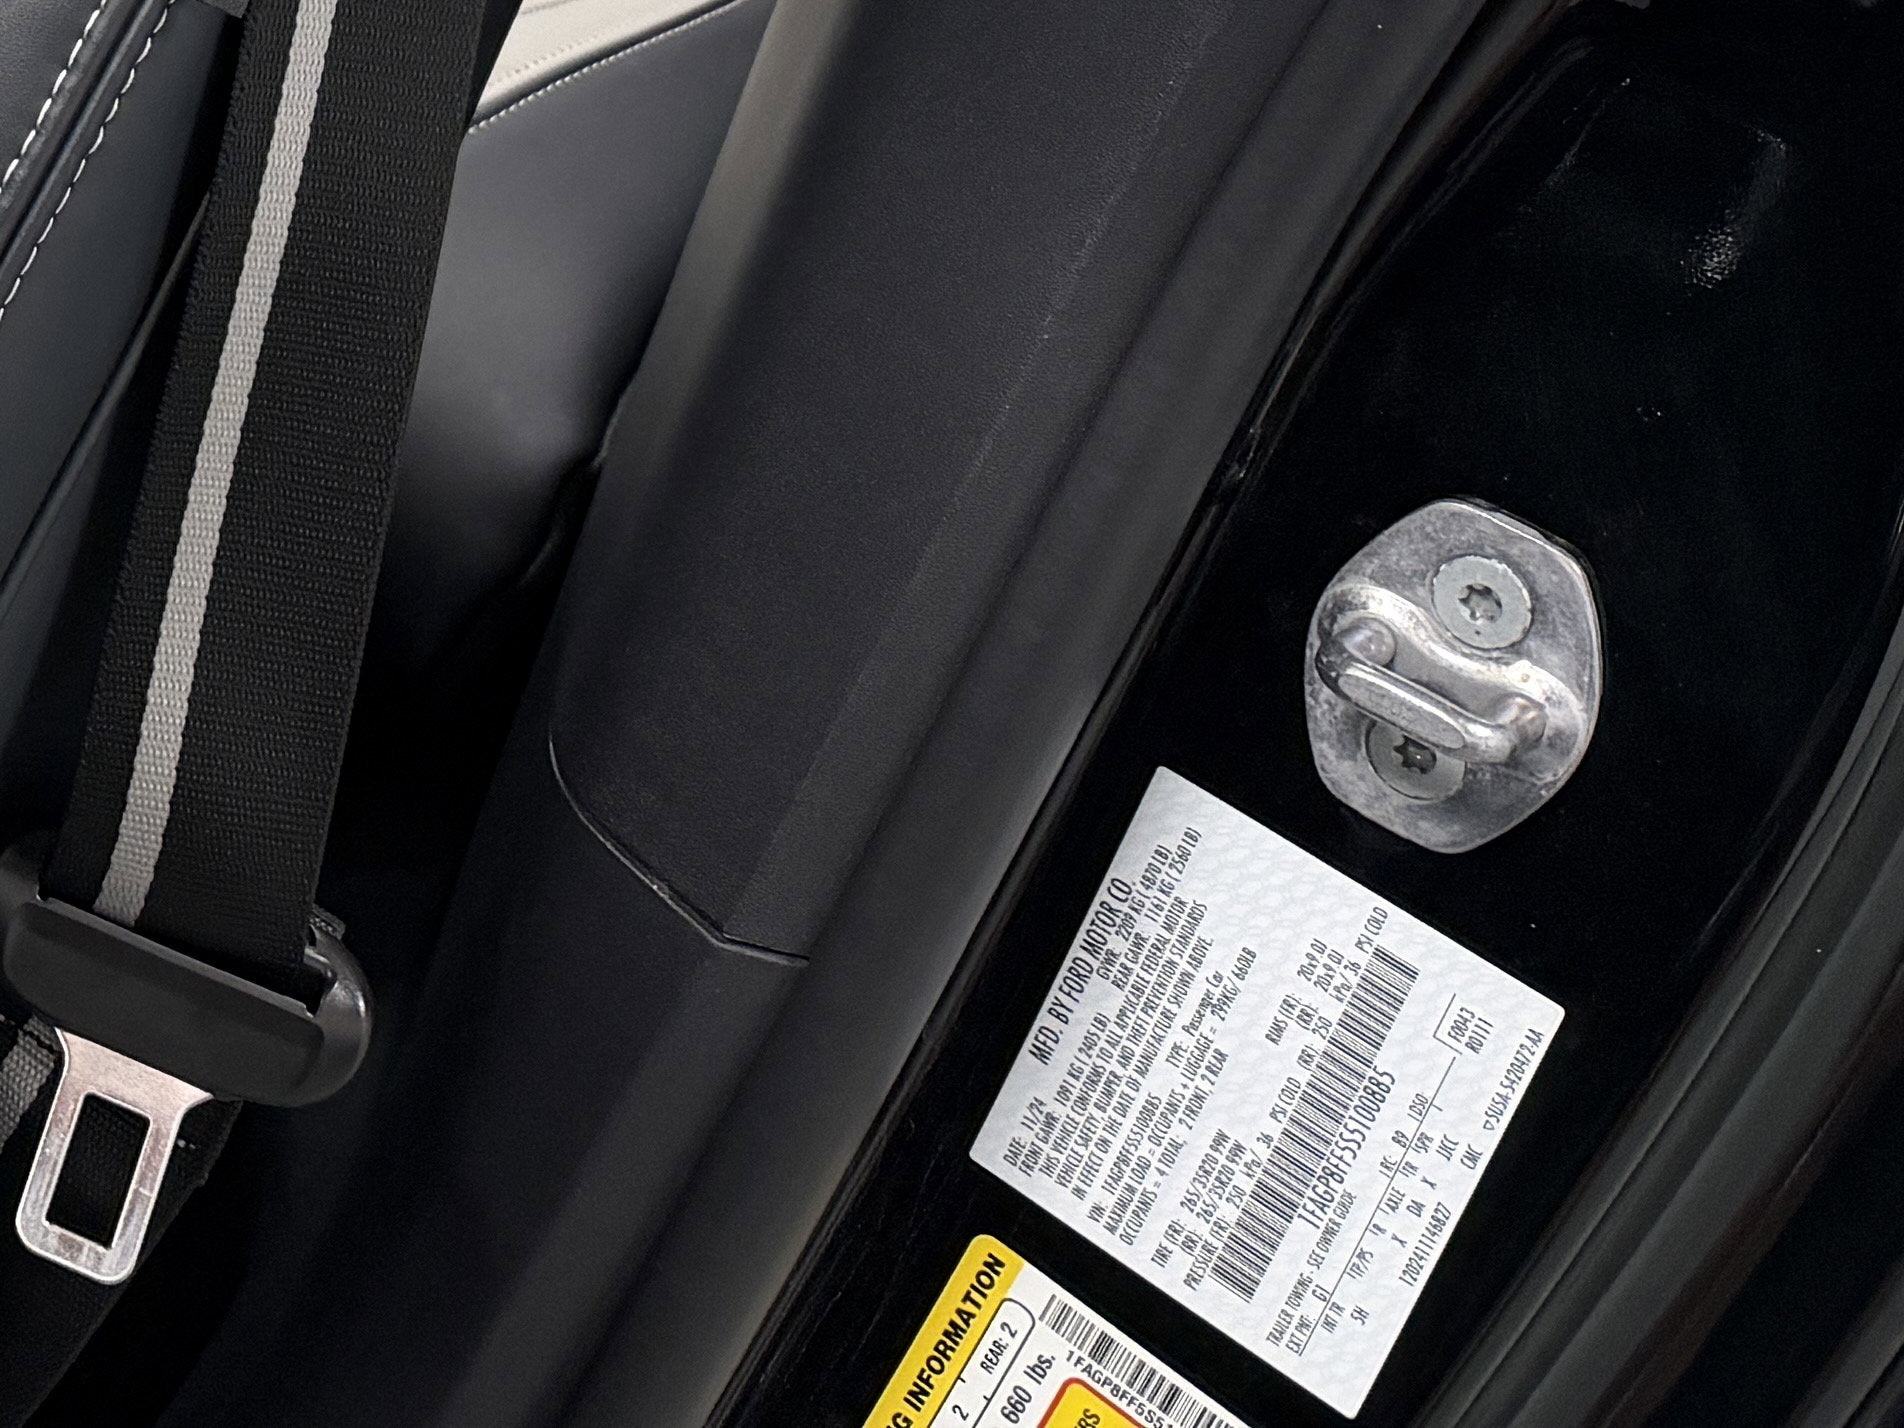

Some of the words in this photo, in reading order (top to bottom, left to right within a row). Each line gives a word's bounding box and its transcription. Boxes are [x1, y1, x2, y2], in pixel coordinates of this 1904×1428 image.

[1105, 877, 1137, 904] CO.
[1078, 899, 1124, 962] MOTOR
[1159, 895, 1190, 936] MOTOR
[1168, 898, 1208, 960] STANDARDS
[1363, 905, 1389, 936] COLD
[1094, 946, 1123, 981] GVWR:
[1126, 895, 1146, 916] KG
[1109, 961, 1135, 993] REAR
[1123, 930, 1152, 965] GAWR:
[1155, 877, 1176, 899] KG
[1353, 932, 1375, 955] PSI
[1138, 932, 1172, 977] FEDERAL
[1184, 935, 1214, 973] ABOVE.
[1342, 958, 1362, 977] 36
[1057, 955, 1095, 1004] FORD
[1139, 955, 1180, 1020] PREVENTION
[1166, 967, 1197, 1009] SHOWN
[1327, 971, 1354, 1004] kPa/
[1045, 994, 1074, 1026] BY
[1112, 971, 1151, 1033] APPLICABLE
[1264, 1015, 1289, 1046] RIMS
[1277, 992, 1302, 1021] (FR):
[1293, 1003, 1320, 1031] (RR):
[1103, 1028, 1124, 1052] ALL
[1124, 1014, 1151, 1048] THEFT
[1131, 1004, 1178, 1080] MANUFACTURE
[1310, 1014, 1333, 1041] 250
[1446, 1006, 1476, 1044] F0043
[1463, 1016, 1494, 1055] R0111
[1027, 1024, 1064, 1066] MFD.
[1094, 1045, 1114, 1065] TO
[1114, 1044, 1136, 1072] AND
[1203, 1047, 1229, 1078] REAR
[1295, 1043, 1320, 1072] (RR):
[1017, 1140, 1045, 1178] FRONT
[1033, 1110, 1063, 1145] GAWR:
[1052, 1078, 1078, 1108] 1091
[1065, 1061, 1085, 1083] KG
[1076, 1028, 1102, 1060] 2405
[1089, 1011, 1112, 1034] LB)
[1069, 1060, 1107, 1117] CONFORMS
[1085, 1201, 1109, 1224] VIN:
[1164, 1040, 1190, 1069] TYPE:
[1180, 987, 1216, 1038] Passenger
[1204, 969, 1224, 989] Car
[1092, 1069, 1127, 1114] BUMPER,
[1124, 1073, 1143, 1093] OF
[1199, 1072, 1216, 1087] 2
[1277, 1076, 1302, 1106] COLD
[1110, 1089, 1136, 1119] DATE
[1181, 1084, 1214, 1122] FRONT,
[1268, 1102, 1289, 1125] PSI
[1001, 1136, 1028, 1168] DATE:
[1019, 1095, 1048, 1132] 11/24
[1048, 1112, 1081, 1156] VEHICLE
[1072, 1111, 1105, 1151] SAFETY,
[1101, 1114, 1123, 1138] THE
[1101, 1181, 1139, 1236] MAXIMUM
[1127, 1154, 1152, 1186] LOAD
[1146, 1087, 1186, 1148] OCCUPANTS
[1179, 1031, 1215, 1083] LUGGAGE
[1177, 1116, 1194, 1131] 2
[1255, 1130, 1275, 1150] 36
[1093, 1133, 1114, 1155] ON
[1296, 1064, 1396, 1230] 1FAGP8FF5S5100885
[1413, 1130, 1435, 1154] SPR
[1459, 1142, 1484, 1171] CMC
[1037, 1152, 1061, 1179] THIS
[1053, 1146, 1085, 1189] VEHICLE
[1076, 1149, 1105, 1188] EFFECT
[1153, 1165, 1170, 1177] 4
[1238, 1147, 1264, 1181] kPa/
[1401, 1160, 1420, 1177] TR
[1070, 1183, 1088, 1201] IN
[1149, 1241, 1174, 1269] TIRE
[1162, 1218, 1187, 1247] (FR):
[1178, 1152, 1219, 1214] 265/35R20
[1208, 1127, 1232, 1156] 99W
[1178, 1228, 1204, 1259] (RR):
[1194, 1163, 1236, 1225] 265/35R20
[1224, 1138, 1248, 1167] 99W
[1224, 1183, 1248, 1210] 250
[1331, 1187, 1358, 1221] GUIDE
[1383, 1185, 1406, 1214] AXLE
[1118, 1186, 1158, 1246] OCCUPANTS
[1208, 1214, 1232, 1244] (FR):
[1371, 1222, 1387, 1235] R
[1390, 1232, 1408, 1249] X
[1405, 1198, 1427, 1218] DA
[1419, 1175, 1438, 1191] X
[1315, 1216, 1343, 1254] OWNER
[1397, 1200, 1452, 1287] 1202411146827
[1182, 1237, 1219, 1292] PRESSURE
[1305, 1248, 1326, 1271] SEE
[1283, 1271, 1314, 1312] TOWING
[1327, 1300, 1346, 1318] TR
[903, 1252, 1006, 1413] INFORMATION
[1264, 1307, 1295, 1348] TRAILER
[1293, 1313, 1316, 1337] PNT:
[1319, 1312, 1339, 1334] INT
[980, 1338, 1009, 1375] REAR:
[1000, 1322, 1018, 1339] 2
[1284, 1331, 1304, 1355] EXT
[1000, 1384, 1033, 1425] 660
[1023, 1353, 1057, 1386] lbs.
[1065, 1349, 1173, 1428] 1FAGP8FF5S5
[952, 1404, 969, 1421] 2
